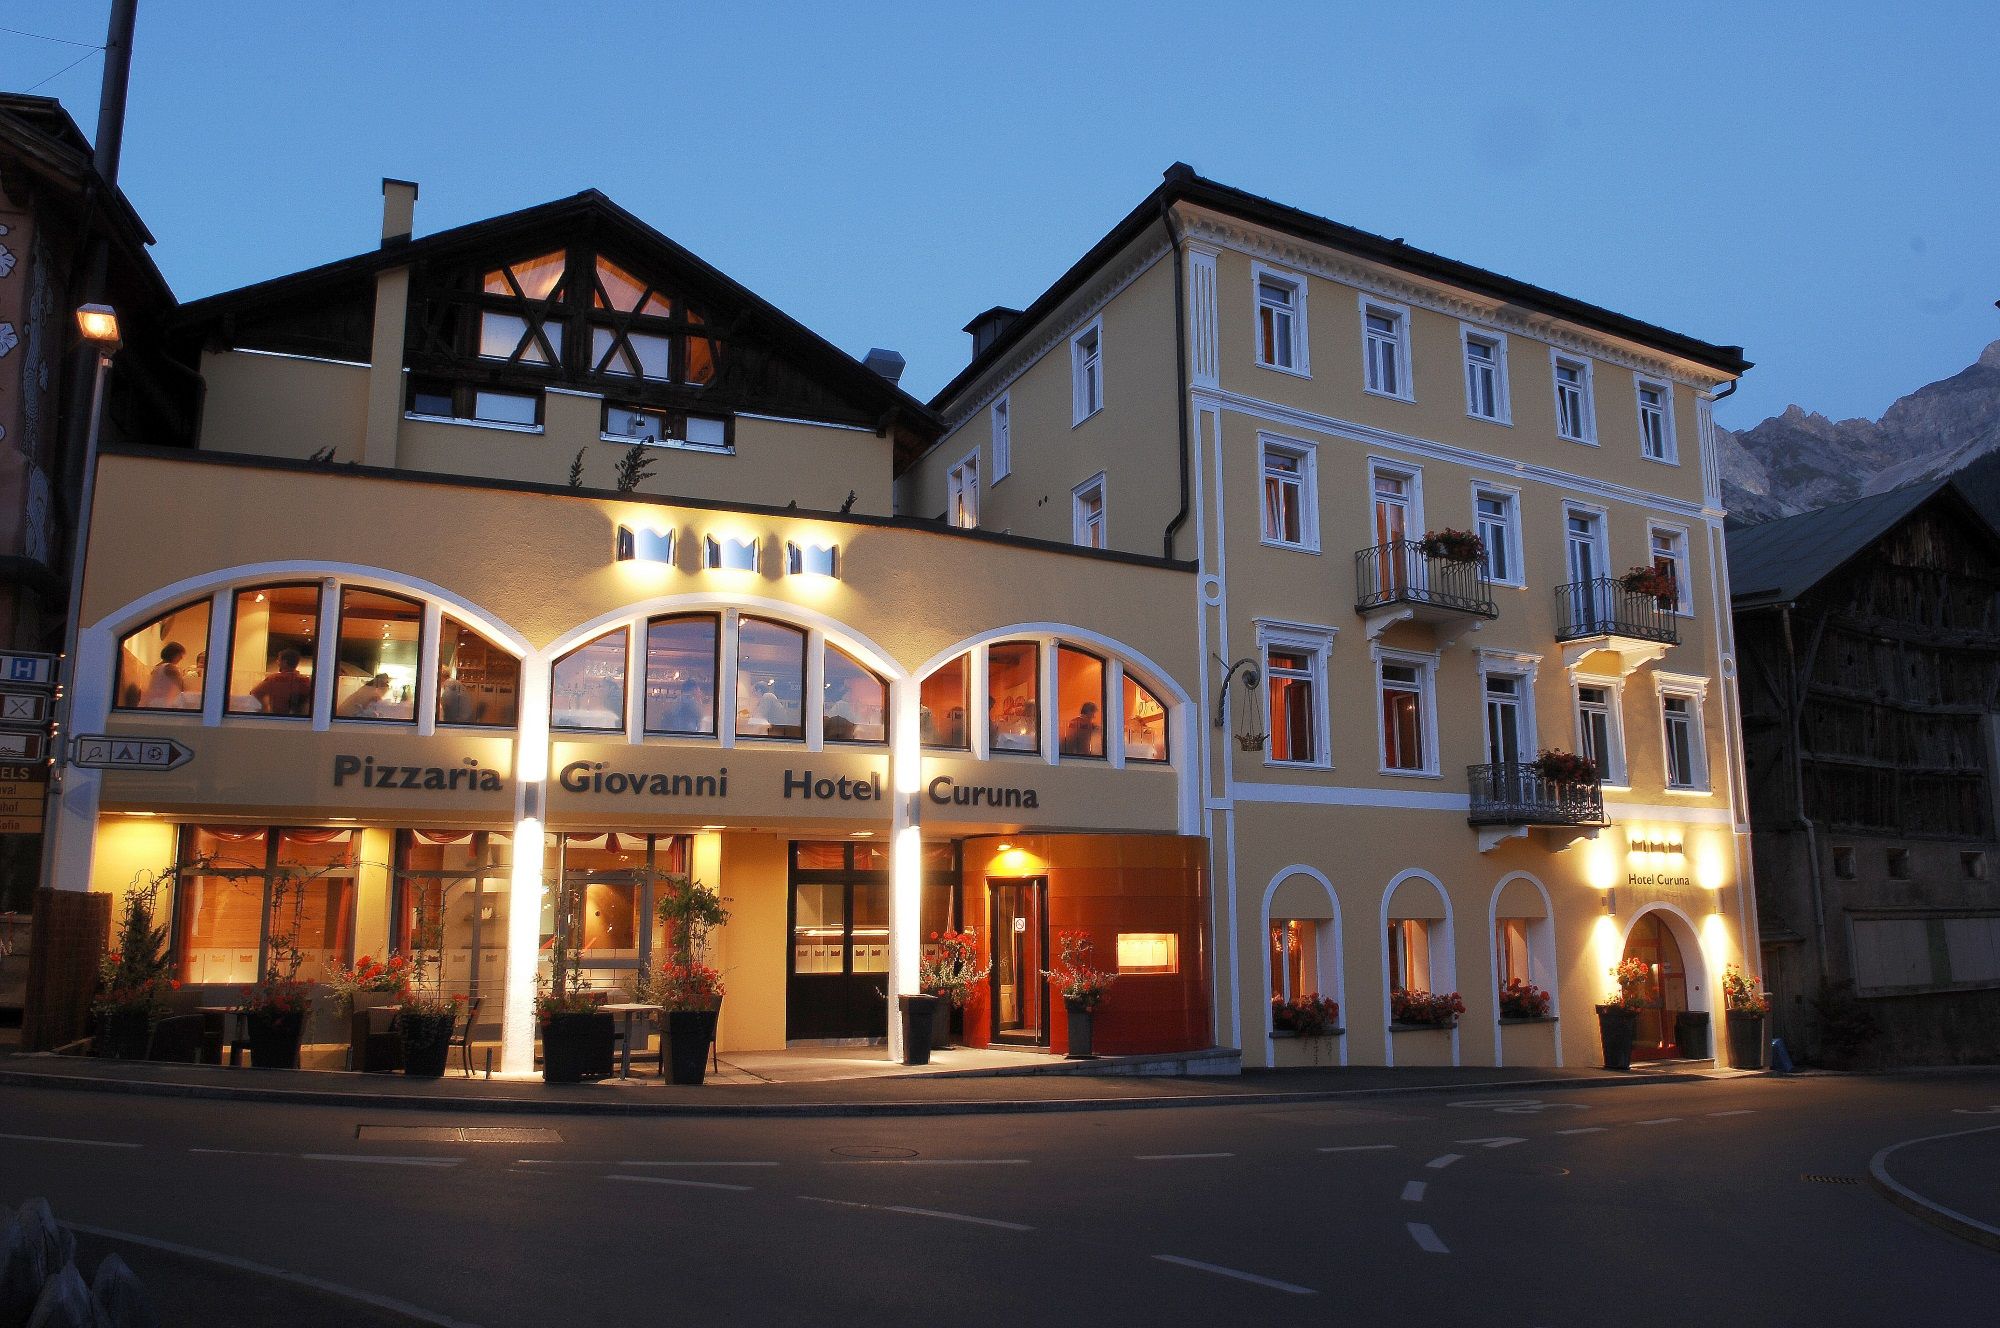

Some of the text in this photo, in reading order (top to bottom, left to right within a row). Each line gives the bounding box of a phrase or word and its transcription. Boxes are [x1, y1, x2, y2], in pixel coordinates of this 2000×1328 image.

[15, 660, 32, 678] H
[0, 766, 30, 780] ELS
[333, 754, 1040, 809] Pizzaria Giovanni Hotel Curuna
[1628, 873, 1690, 886] Hotel Curuna
